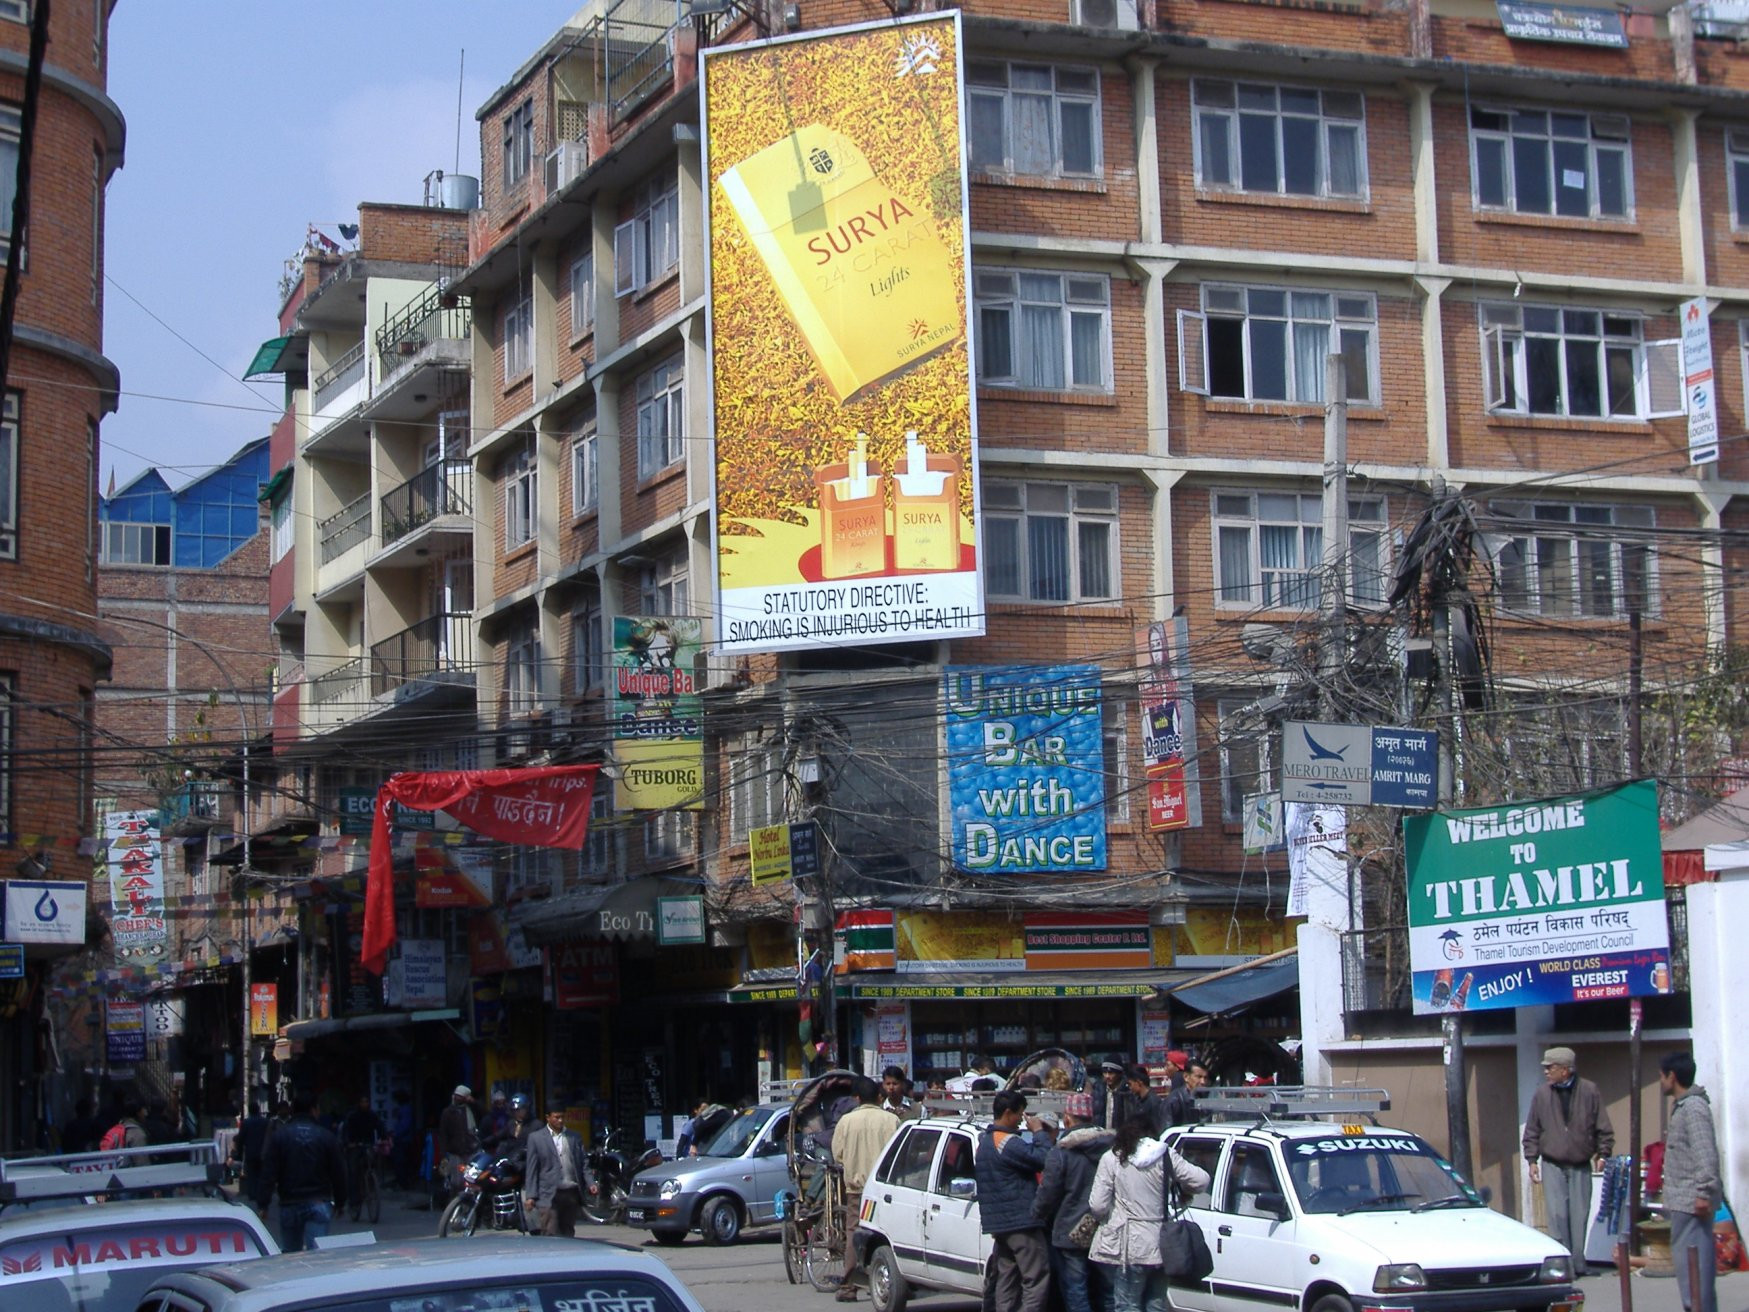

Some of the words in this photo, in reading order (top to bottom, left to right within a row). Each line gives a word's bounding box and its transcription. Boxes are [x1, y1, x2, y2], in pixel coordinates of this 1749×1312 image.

[808, 197, 914, 266] SURYA
[853, 219, 933, 273] CARAT
[870, 266, 910, 298] Lights
[897, 338, 927, 358] SURYA
[927, 323, 956, 342] NEPAL
[1691, 412, 1711, 424] GLOBAL
[1690, 423, 1715, 438] LOGISTICS
[839, 515, 876, 531] SURYA
[903, 512, 942, 525] SURYA
[848, 527, 878, 540] CARAT
[764, 588, 846, 614] STATUTORY
[851, 582, 928, 609] DIRECTIVE:
[730, 617, 792, 643] SMOKING
[797, 617, 810, 637] IS
[814, 611, 888, 636] INJURIOUS
[892, 609, 911, 631] TO
[915, 606, 970, 629] HEALTH
[618, 667, 669, 699] Unique
[673, 668, 692, 694] Ba
[1146, 734, 1181, 757] Dance
[1375, 736, 1401, 752] अमृत
[1405, 737, 1427, 751] मार्ग
[631, 769, 697, 785] TUBORG
[1285, 763, 1320, 777] MERO
[1373, 770, 1402, 783] AMRIT
[1404, 772, 1431, 784] MARG
[979, 778, 1073, 816] with
[1152, 797, 1163, 809] San
[1163, 793, 1182, 809] Miguel
[1317, 792, 1352, 801] 4-258732
[397, 815, 418, 824] SINCE
[419, 815, 432, 824] 1992
[1447, 800, 1585, 844] WELCOME
[759, 826, 781, 845] Hotel
[1510, 842, 1537, 864] TO
[431, 887, 453, 895] Kodak
[1426, 859, 1643, 918] THAMEL
[115, 919, 163, 931] CHEF'S
[600, 911, 631, 931] Eco
[1473, 922, 1500, 941] ठमेल
[1506, 917, 1539, 937] पर्यटन
[1546, 914, 1584, 933] विकास
[1591, 908, 1631, 930] परिषद्
[1027, 934, 1048, 945] Best
[1049, 934, 1091, 946] Shopping
[1092, 933, 1121, 944] Center
[1132, 932, 1147, 943] Ltd.
[1475, 945, 1506, 960] Thamel
[1508, 943, 1539, 957] Tourism
[1542, 937, 1599, 955] Development
[1601, 934, 1634, 948] Council
[404, 954, 443, 966] Himalayan
[561, 944, 615, 968] ATM
[405, 965, 430, 974] Rescue
[1539, 961, 1570, 974] WORLD
[1573, 958, 1600, 971] CLASS
[405, 975, 446, 984] Association
[1478, 972, 1523, 1001] ENJOY
[1572, 970, 1628, 987] EVEREST
[405, 984, 425, 996] Nepal
[861, 987, 878, 997] SINCE
[895, 987, 934, 996] DEPARTMENT
[935, 986, 955, 996] STORE
[963, 986, 981, 996] SINCE
[997, 986, 1036, 996] DEPARTMENT
[1037, 985, 1056, 995] STORE
[1064, 985, 1081, 995] SINCE
[1097, 985, 1134, 994] DEPARTMENT
[1577, 988, 1590, 998] It's
[1591, 989, 1605, 998] our
[1606, 987, 1625, 997] Beer
[108, 1034, 144, 1044] UNIQUE
[1343, 1125, 1363, 1135] TAXI
[1317, 1138, 1419, 1152] SUZUKI
[53, 1231, 246, 1268] MARUTI
